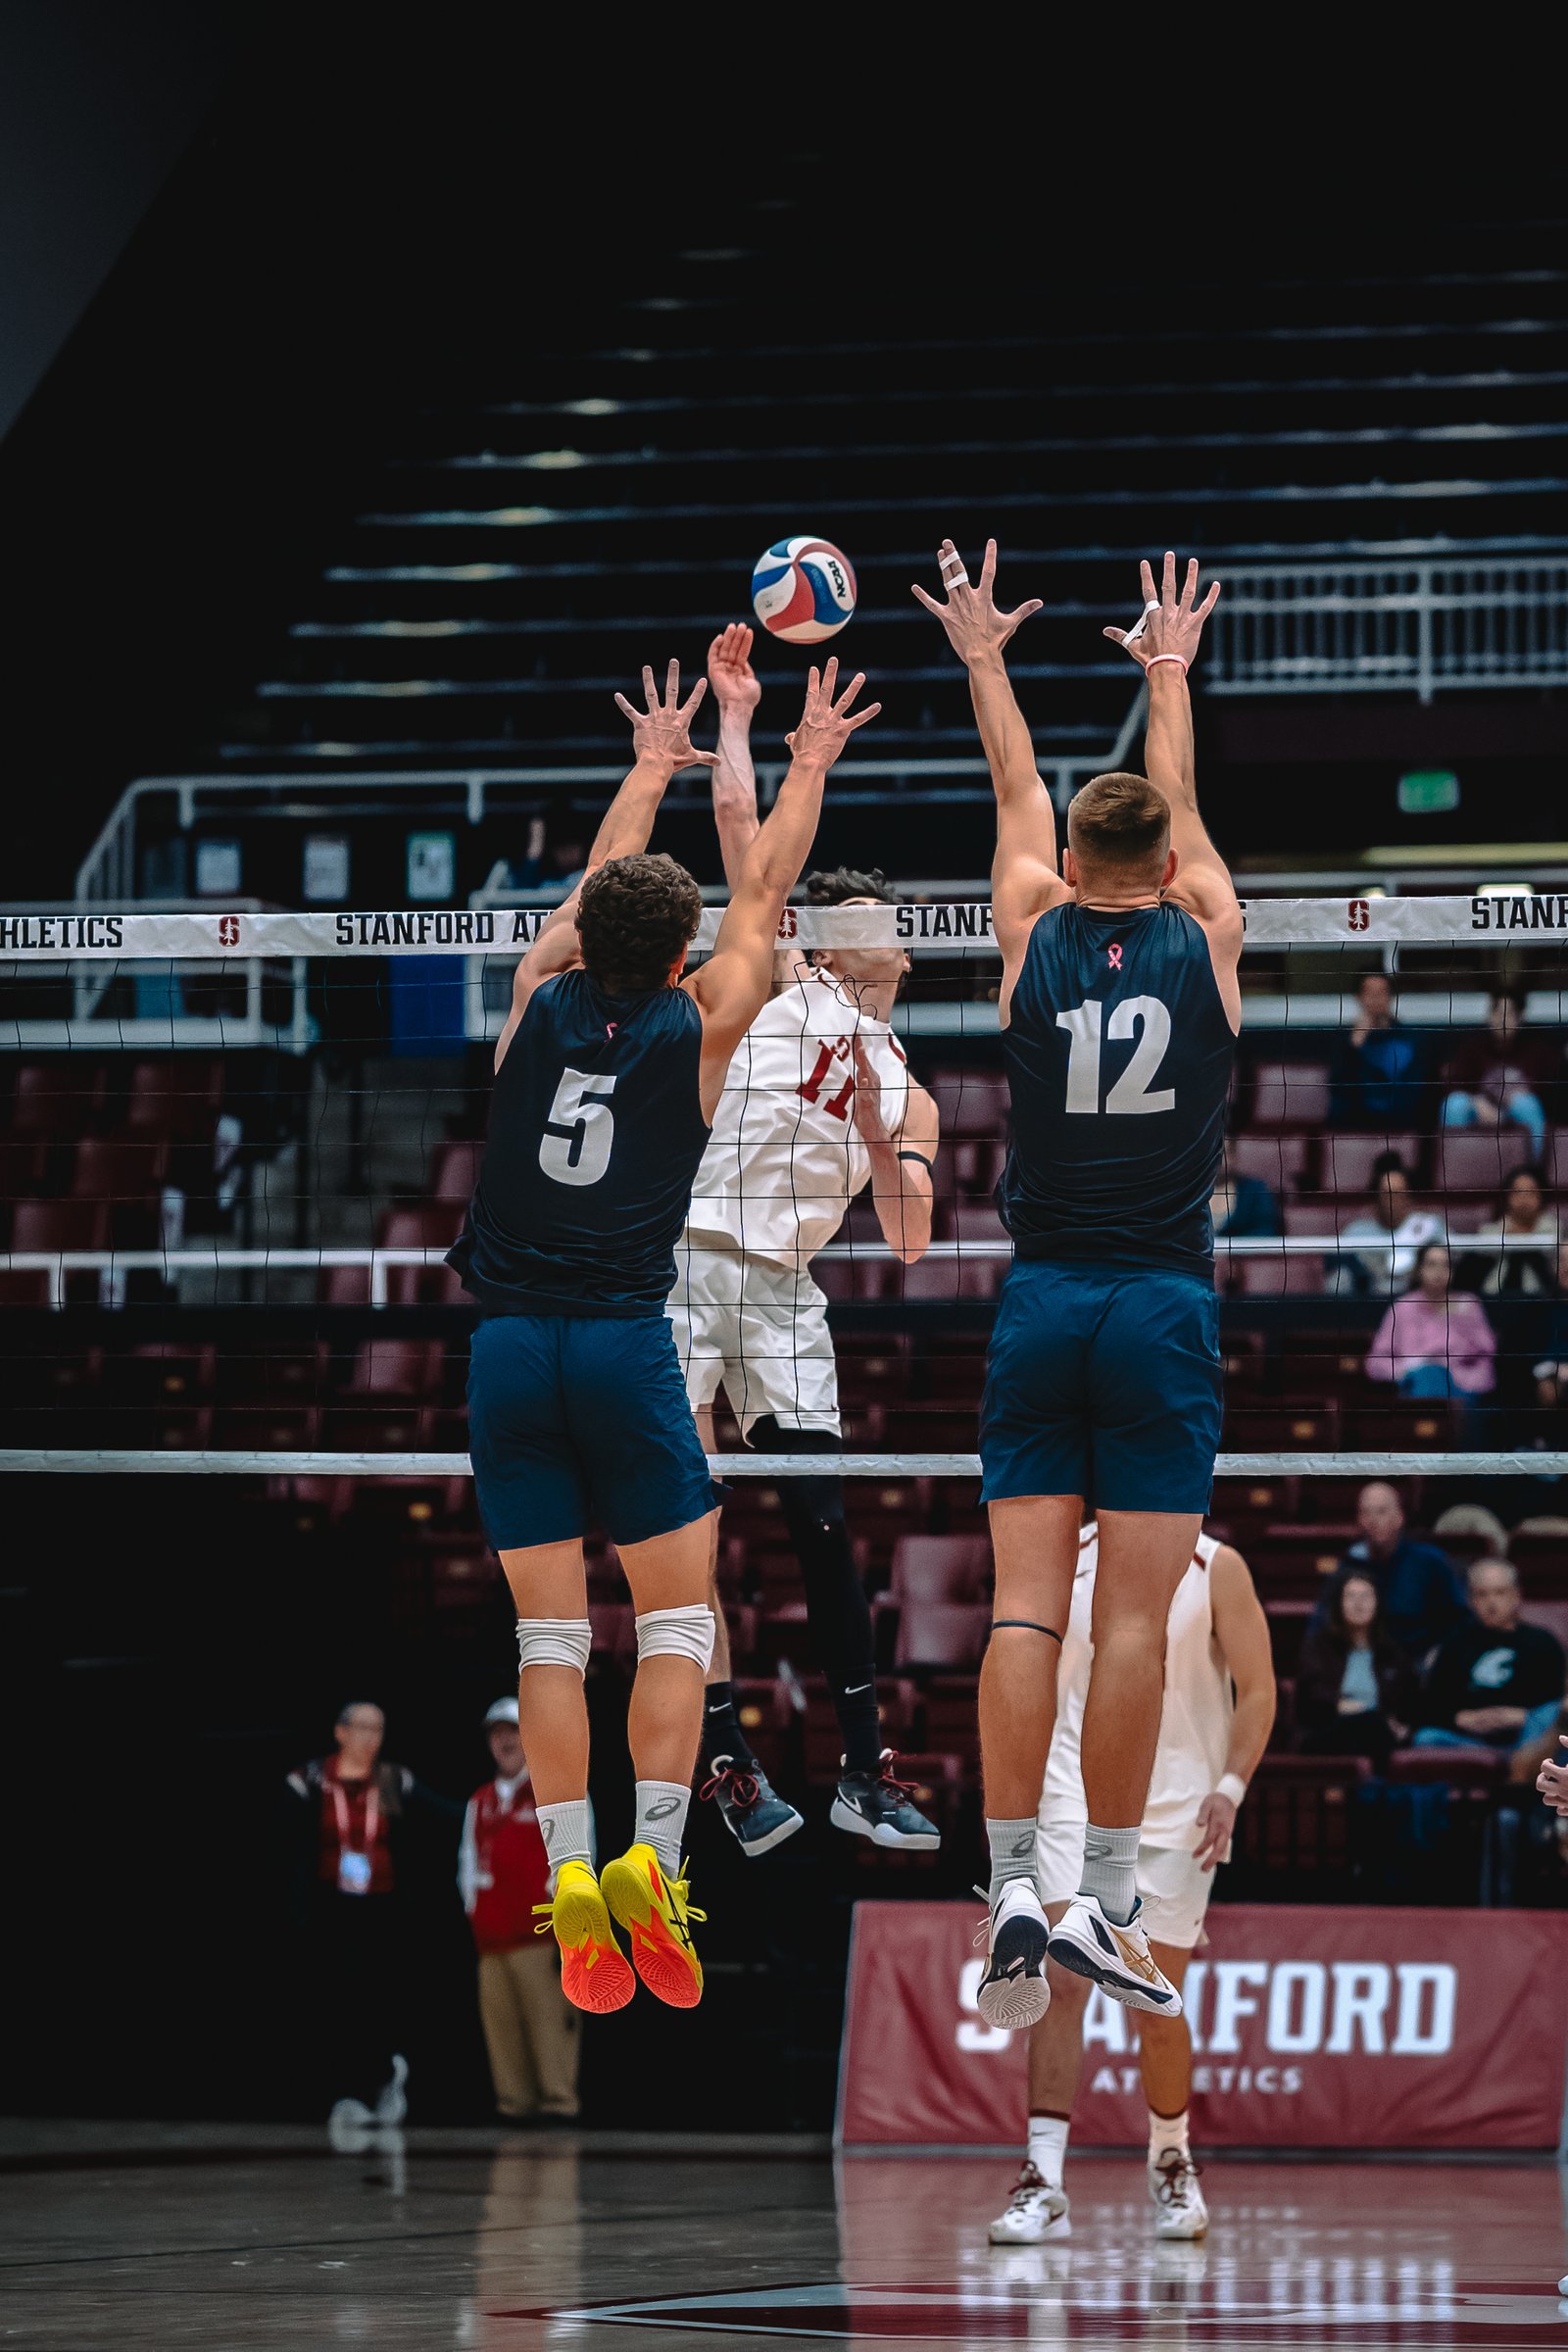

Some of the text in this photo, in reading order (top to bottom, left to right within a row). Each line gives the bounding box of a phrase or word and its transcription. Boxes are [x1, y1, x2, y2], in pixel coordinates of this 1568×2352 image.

[826, 560, 847, 599] NCAA
[0, 916, 123, 949] HLETICS
[335, 910, 555, 946] STANFORD AT
[1055, 994, 1176, 1114] 12
[538, 1066, 618, 1187] 5
[1090, 2065, 1303, 2095] ATETICS
